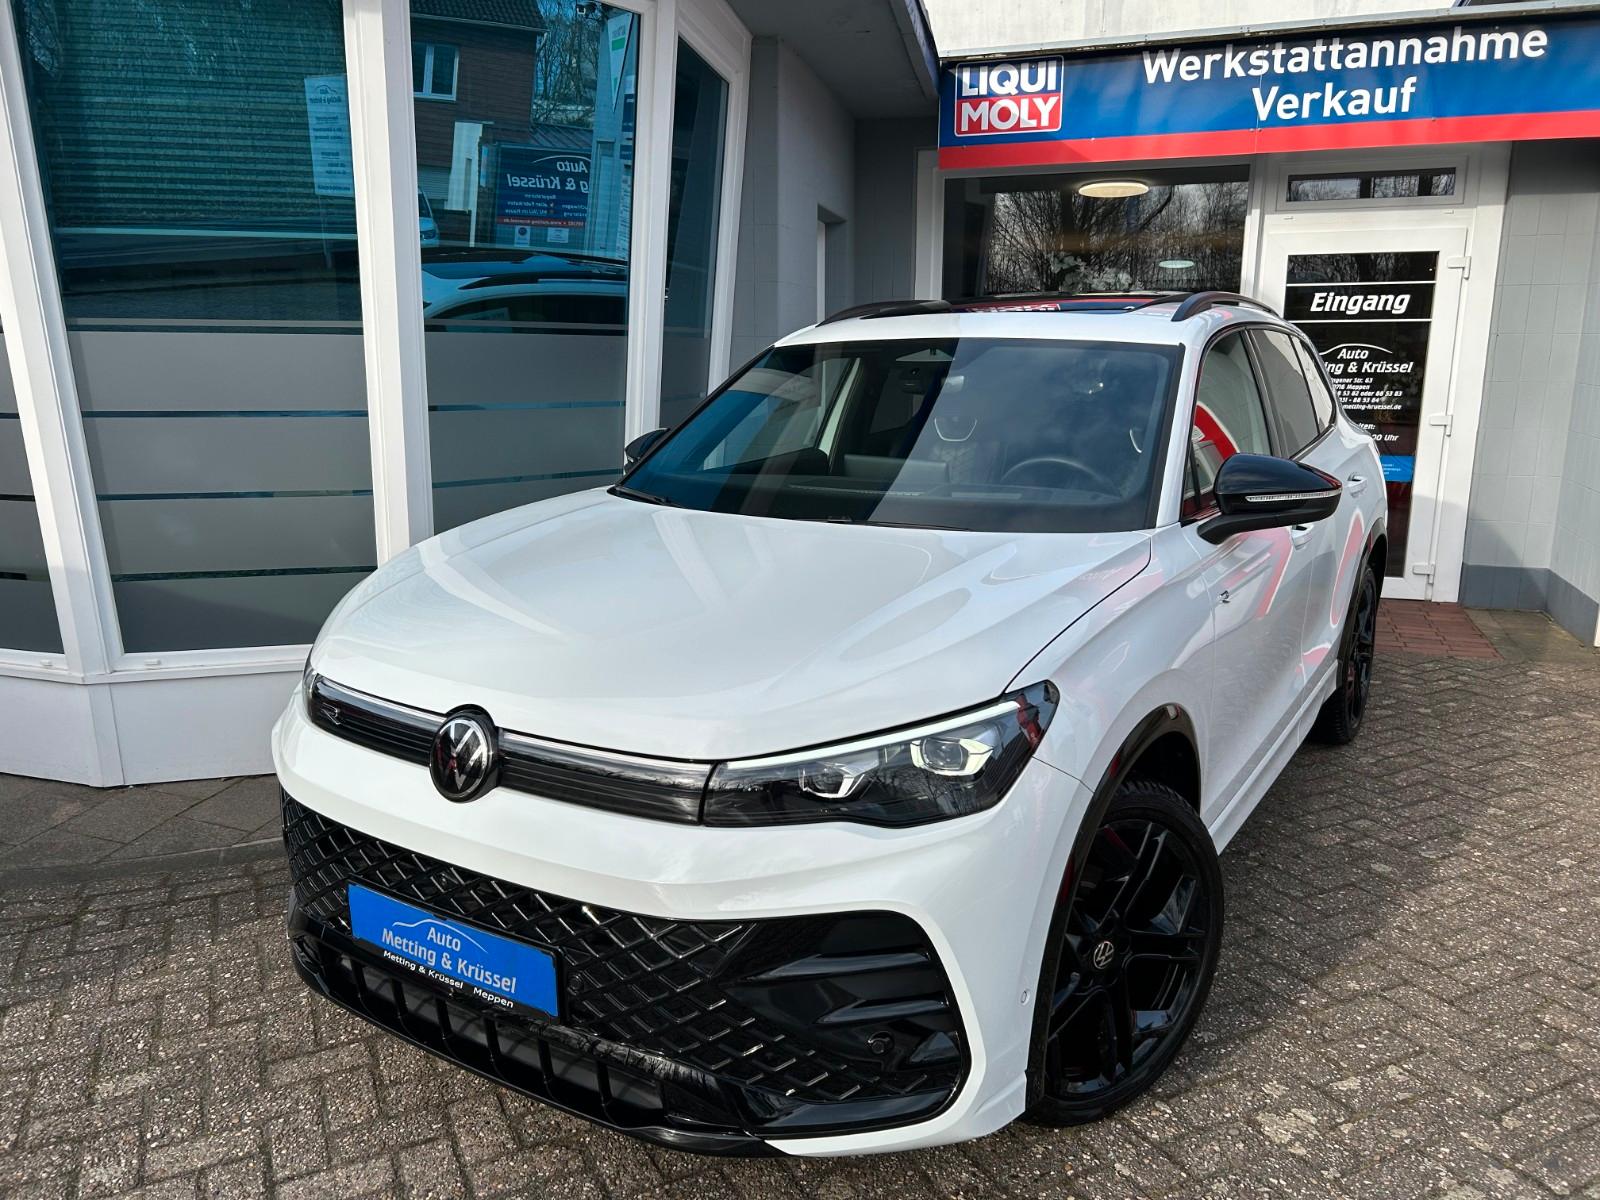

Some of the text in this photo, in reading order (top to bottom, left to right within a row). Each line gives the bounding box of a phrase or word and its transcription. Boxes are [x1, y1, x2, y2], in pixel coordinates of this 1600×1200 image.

[1143, 26, 1548, 84] Werkstattannahme
[961, 60, 1057, 96] LIQUI
[960, 96, 1060, 132] MOLY
[1252, 76, 1418, 121] Verkauf
[1310, 291, 1411, 315] Eingang
[1337, 348, 1369, 359] Auto
[1347, 361, 1358, 373] &
[1361, 361, 1414, 373] Krüssel
[1384, 434, 1400, 442] Uhr
[427, 926, 461, 952] Auto
[382, 928, 517, 994] Metting & Krüssel
[383, 950, 514, 1009] Metting & Krüssel Meppen
